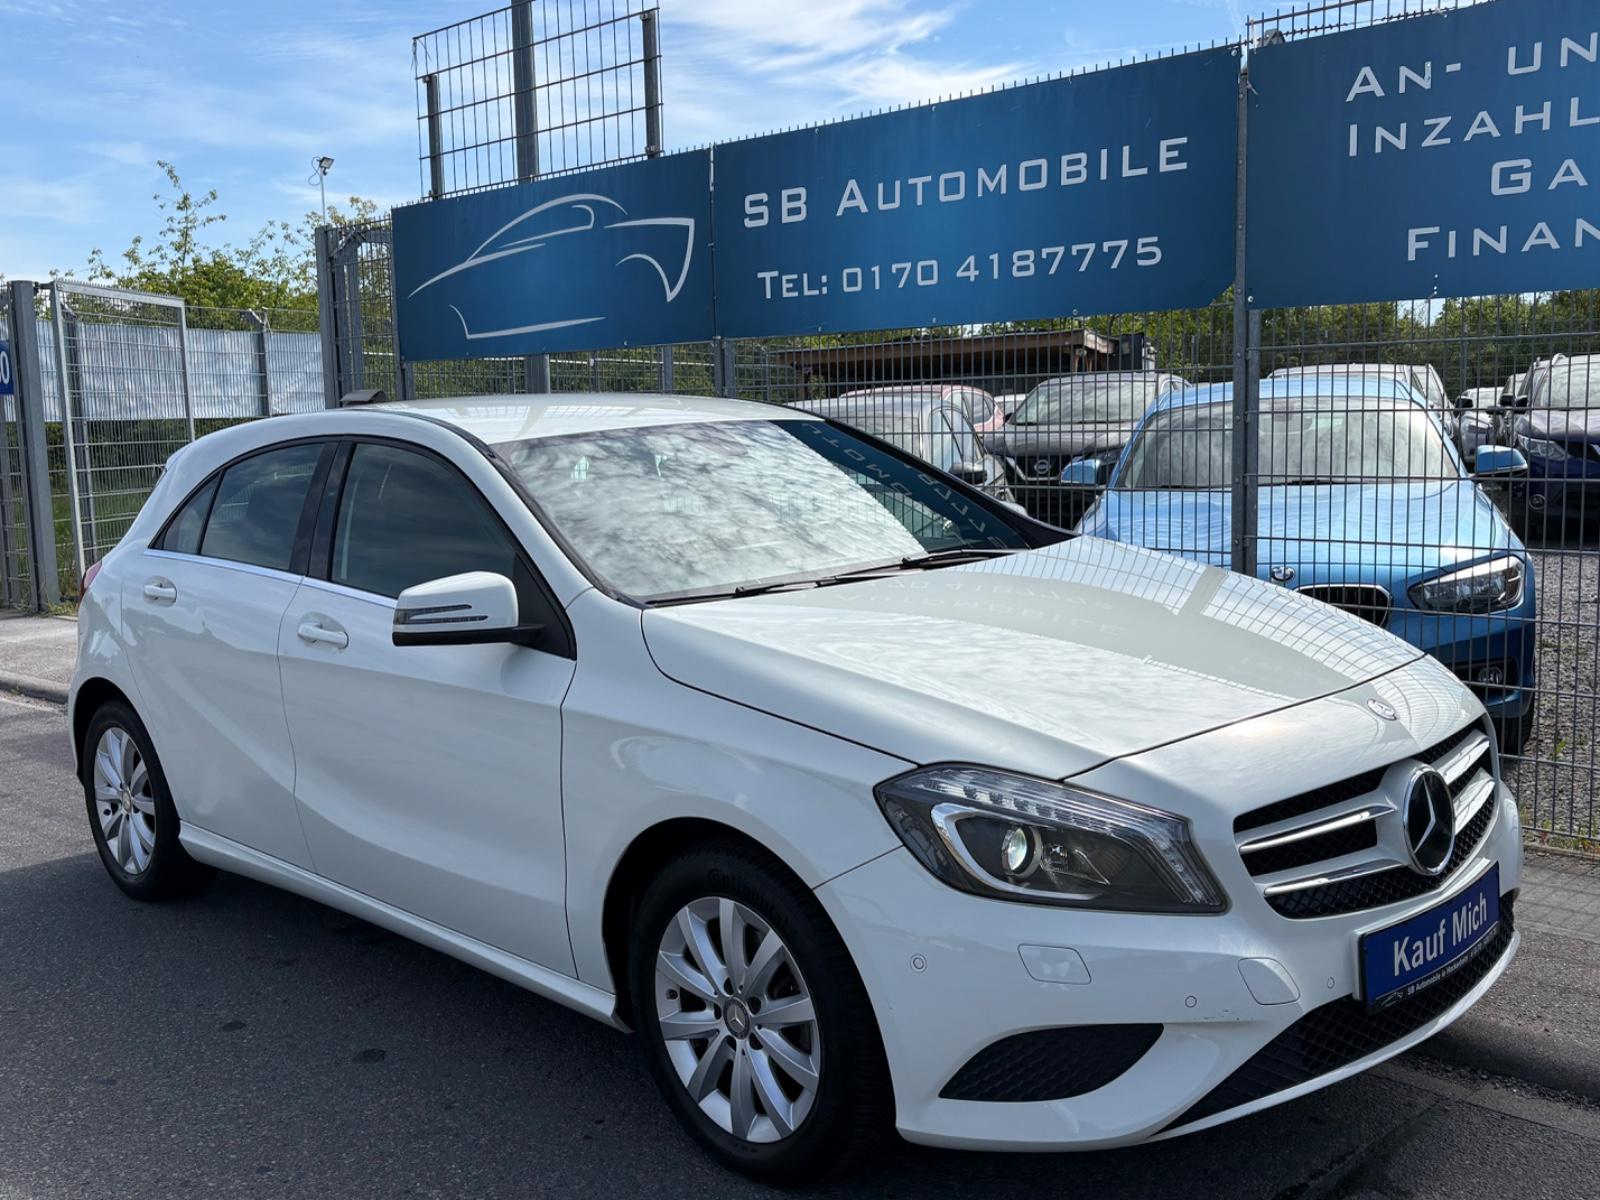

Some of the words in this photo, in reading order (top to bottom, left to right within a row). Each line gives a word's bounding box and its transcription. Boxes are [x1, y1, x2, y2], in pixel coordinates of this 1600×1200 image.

[1349, 97, 1600, 157] INZAHL
[743, 187, 807, 228] SB
[842, 259, 938, 293] 0170
[956, 236, 1162, 283] 4187775
[1394, 918, 1446, 977] Kauf
[1452, 892, 1487, 946] Mich
